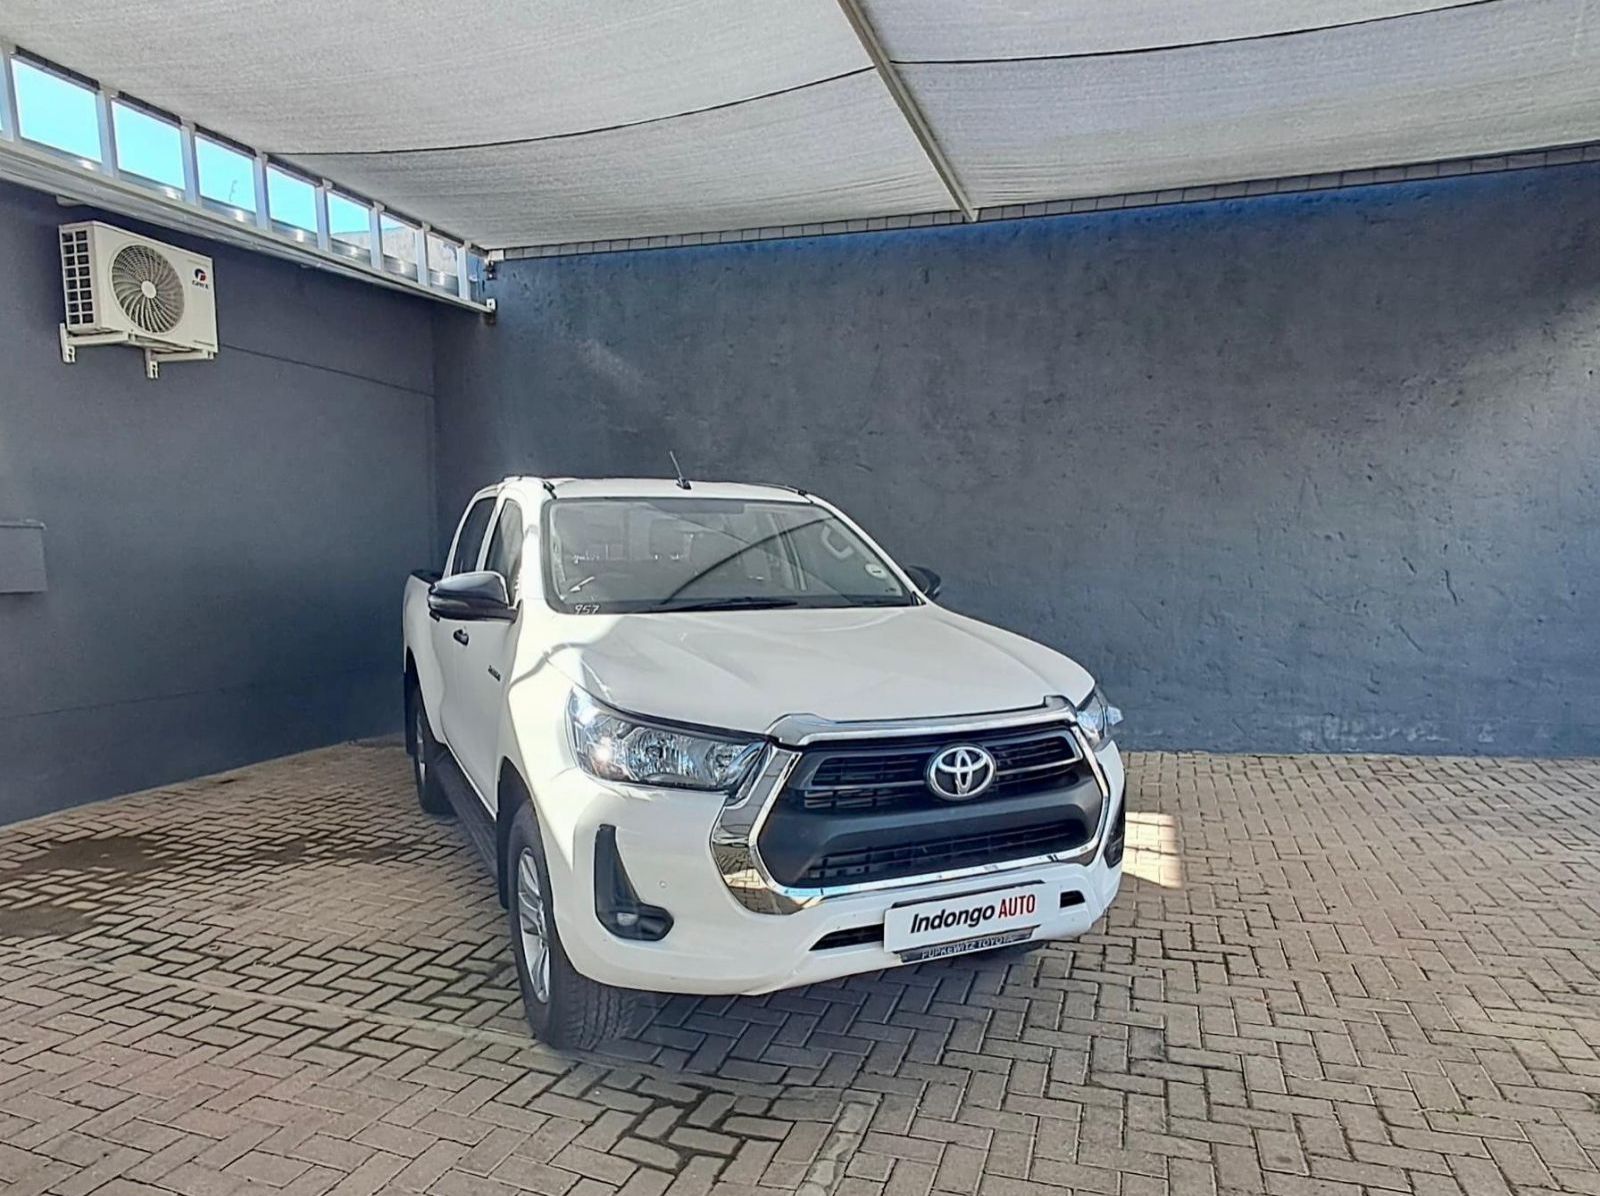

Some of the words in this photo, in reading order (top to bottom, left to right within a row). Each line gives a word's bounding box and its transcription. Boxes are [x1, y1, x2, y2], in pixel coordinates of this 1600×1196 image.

[575, 604, 600, 615] 957
[910, 904, 995, 934] Indongo
[998, 894, 1036, 919] AUTO
[978, 936, 1014, 949] TOYOTA
